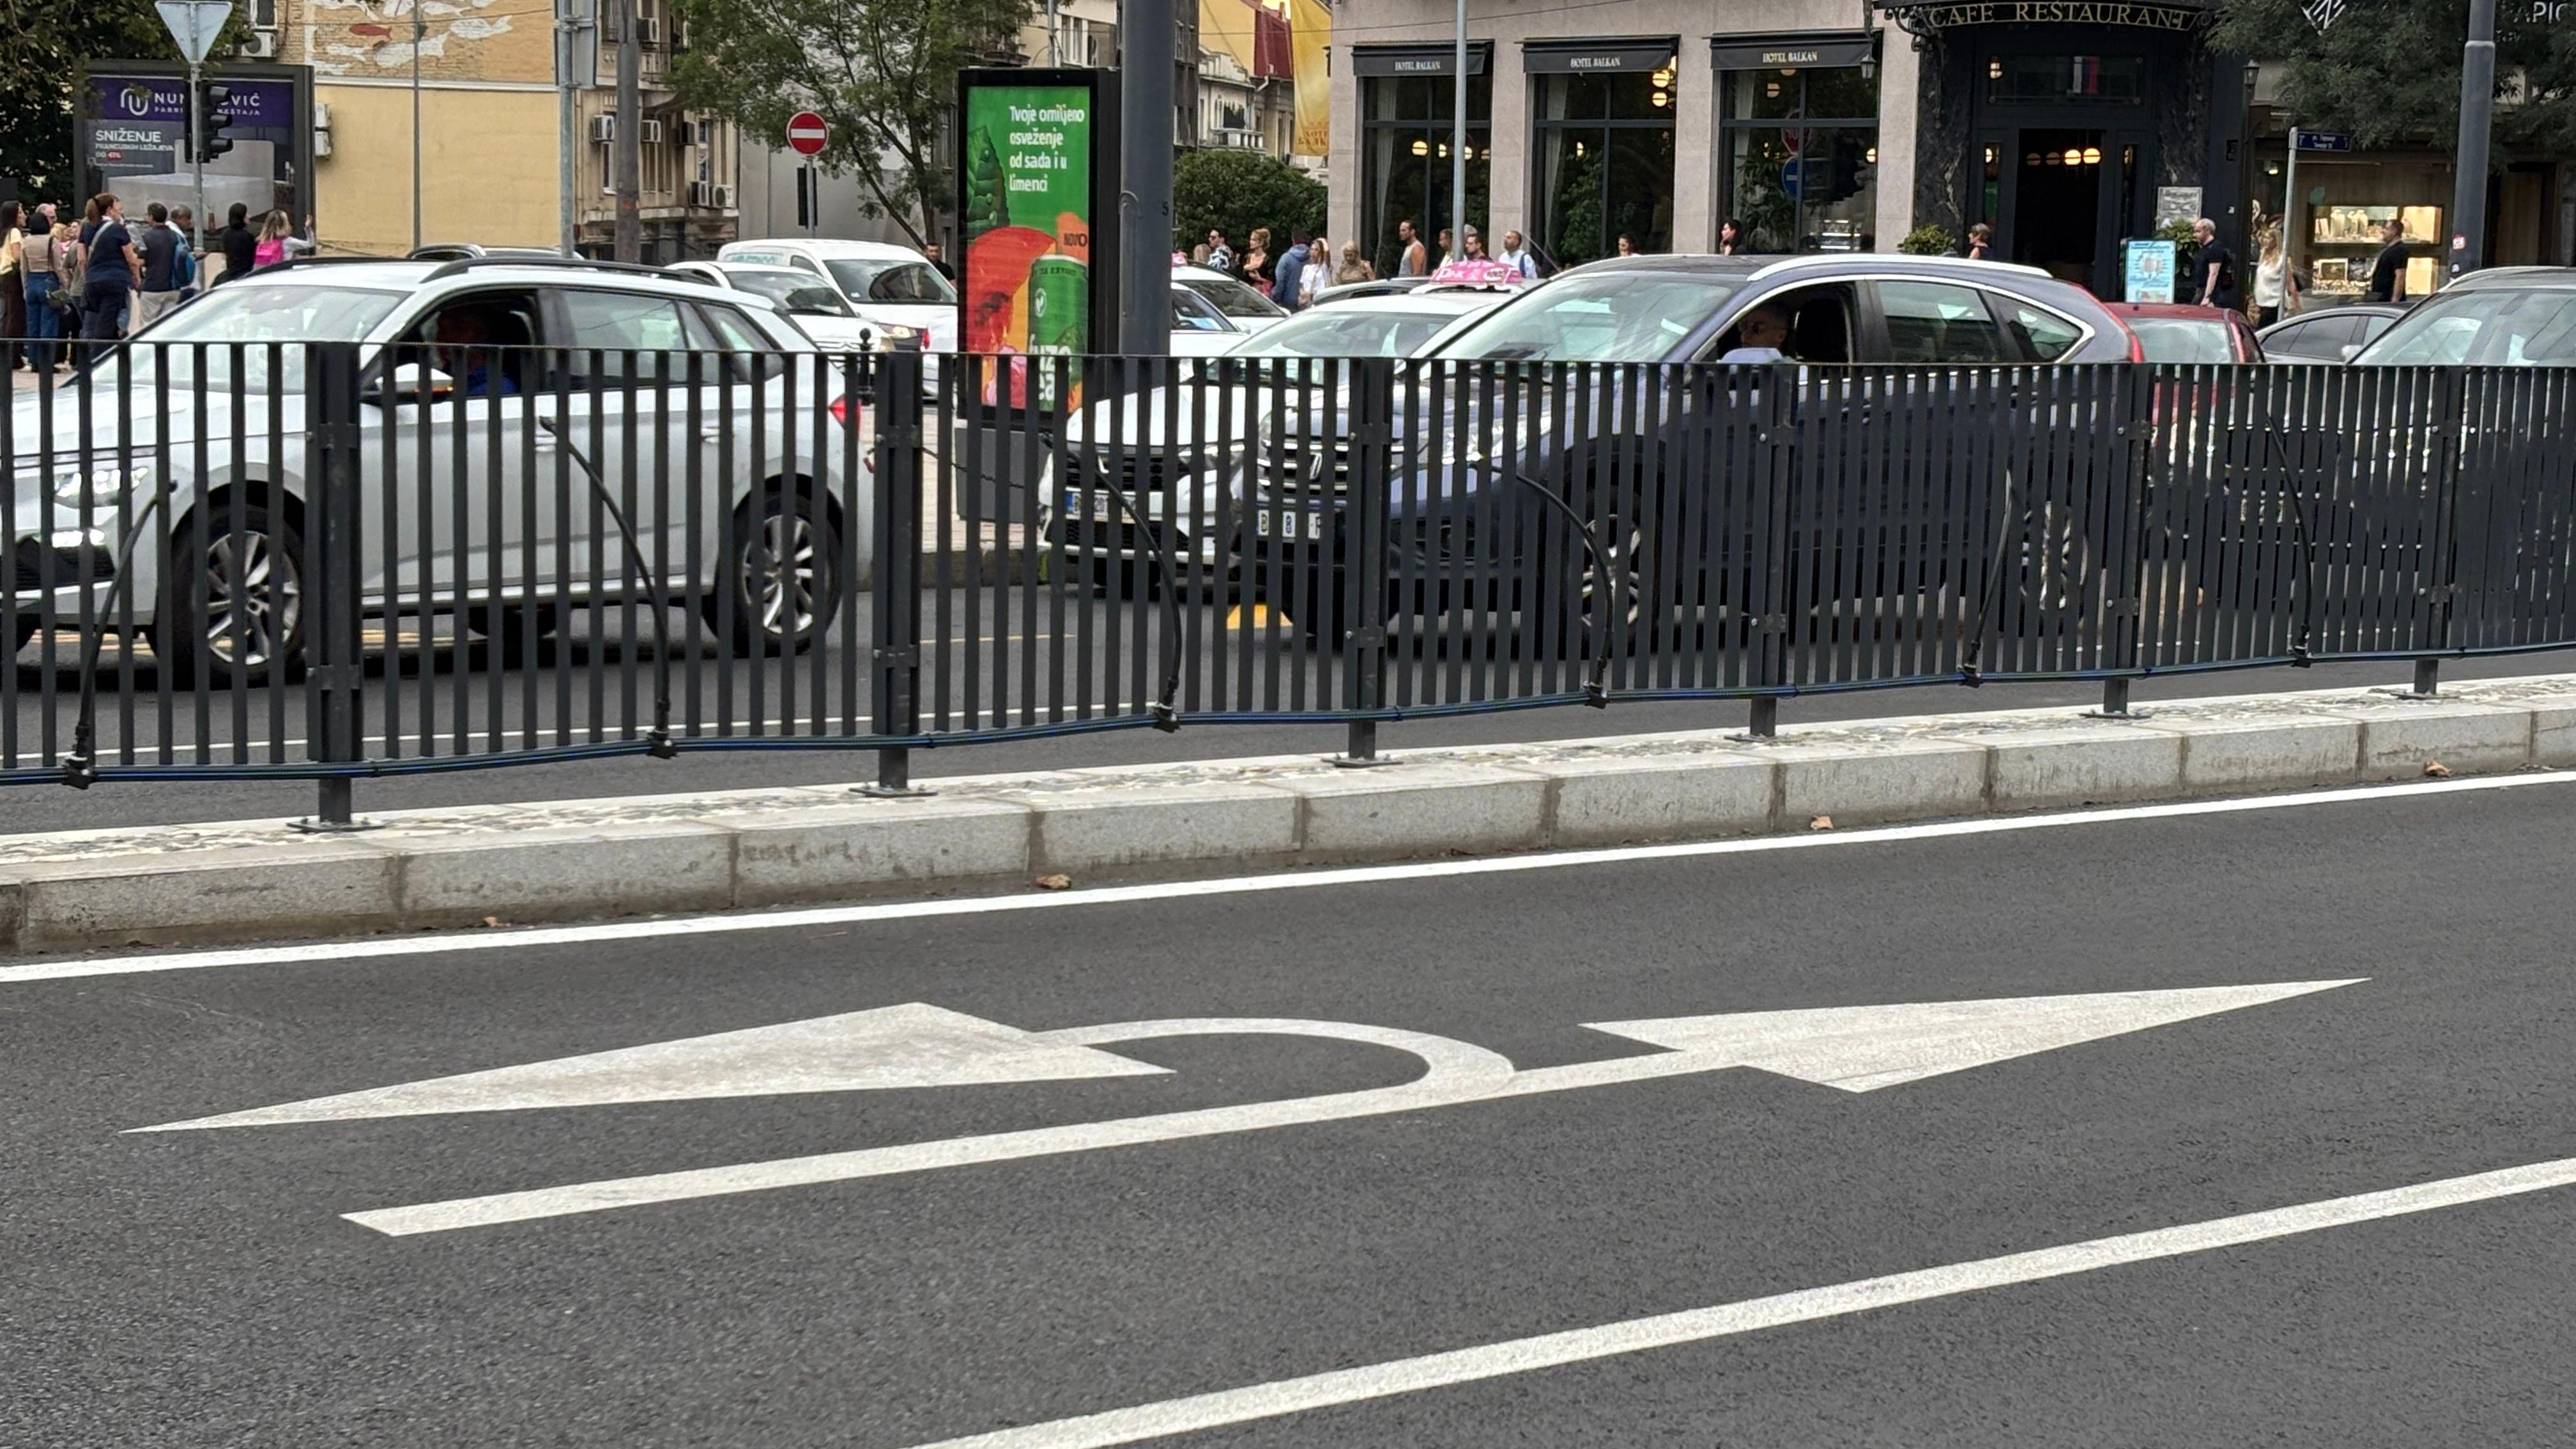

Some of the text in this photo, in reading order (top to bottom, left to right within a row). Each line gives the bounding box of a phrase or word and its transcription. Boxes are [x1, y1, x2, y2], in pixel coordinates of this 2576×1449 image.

[2014, 2, 2190, 30] RESTAURANT
[1593, 56, 1621, 66] BALKAN
[1763, 52, 1818, 63] HOTEL BALKAN
[1009, 103, 1085, 126] Tvoje omiljeno
[95, 127, 162, 142] SNIŽENJE
[1009, 127, 1064, 150] osveženje
[1009, 150, 1067, 169] od sada i u
